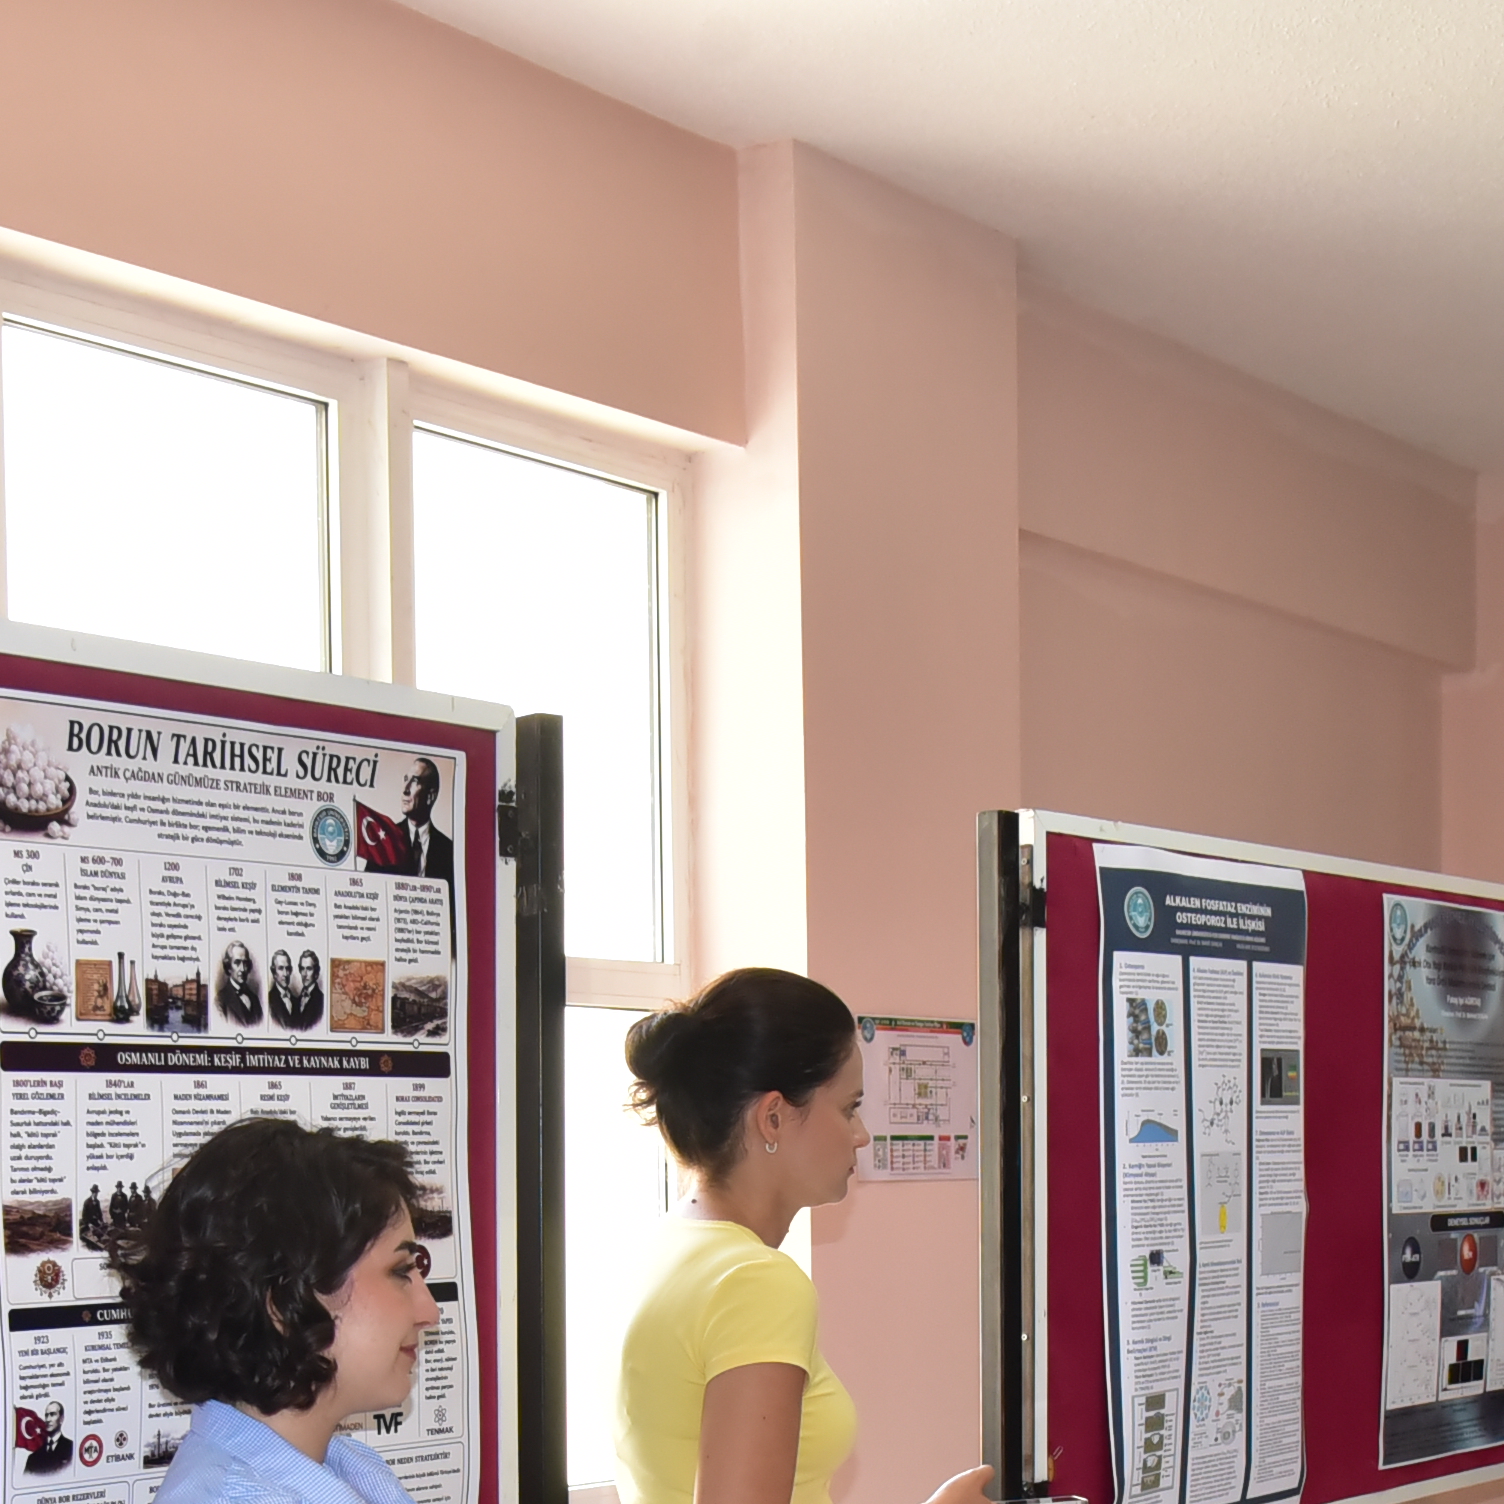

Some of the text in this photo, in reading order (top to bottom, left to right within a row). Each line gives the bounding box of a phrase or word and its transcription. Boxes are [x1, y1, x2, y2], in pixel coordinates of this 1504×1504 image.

[67, 720, 379, 788] BORUN TARİHSEL SÜRECİ
[88, 764, 335, 803] ANTİK ÇAĞDAN GÜNÜMÜZE STRATEJİK ELEMENT BOR
[204, 798, 217, 808] olan
[232, 801, 241, 810] bir
[13, 850, 40, 860] MS 300
[21, 862, 33, 874] ÇİN
[164, 862, 180, 872] 1200
[228, 867, 243, 877] 1702
[80, 867, 126, 880] İSLAM DÜNYASI
[287, 872, 303, 882] 1808
[161, 875, 184, 885] AVRUPA
[349, 877, 363, 887] 1865
[1165, 894, 1201, 909] ALKALEN
[1201, 898, 1236, 913] FOSFATAZ
[1176, 911, 1266, 933] OSTEOPOROZ İLE İLİŞKİSİ
[117, 1050, 370, 1070] OSMANLI DÖNEMİ: KEŞİF, İMTİYAZ VE KAYNAK KAYBI
[193, 1080, 208, 1089] 1861
[267, 1080, 282, 1090] 1865
[33, 1335, 49, 1345] 1923
[97, 1331, 113, 1340] 1935
[373, 1411, 404, 1436] TVF
[426, 1426, 454, 1436] TENMAK
[106, 1452, 135, 1464] ETİBANK
[58, 1494, 70, 1503] BOR
